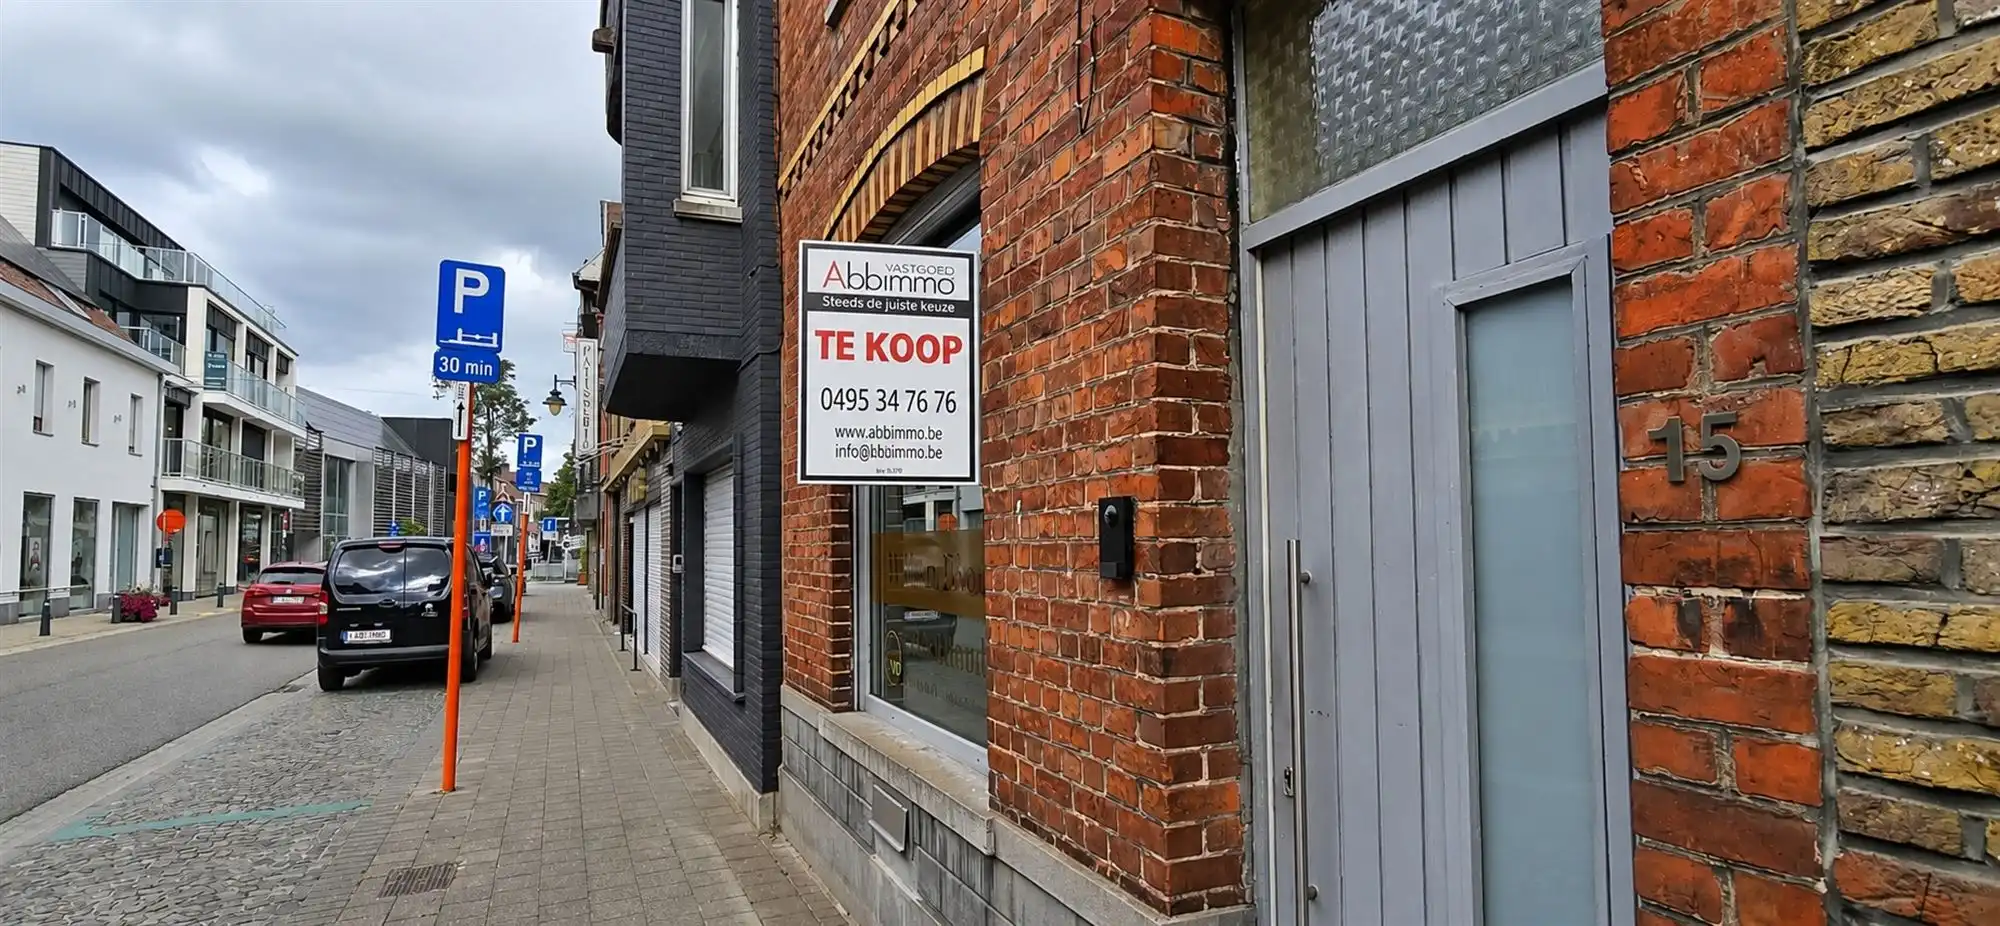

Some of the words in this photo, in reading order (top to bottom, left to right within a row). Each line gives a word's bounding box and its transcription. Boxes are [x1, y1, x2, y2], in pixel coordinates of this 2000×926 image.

[822, 260, 955, 295] Abbimmo
[885, 263, 955, 276] VASTGOED
[453, 268, 490, 315] P
[822, 295, 864, 309] Steeds
[866, 297, 882, 310] de
[885, 298, 918, 312] juiste
[920, 300, 955, 313] keuze
[815, 329, 855, 361] TE
[866, 332, 963, 364] KOOP
[438, 355, 459, 374] 30
[464, 358, 494, 378] min
[820, 387, 869, 411] 0495
[875, 388, 899, 412] 34
[905, 389, 928, 413] 76
[934, 390, 957, 413] 76
[835, 425, 943, 441] www.abbimmo.be
[523, 437, 537, 454] P
[1646, 411, 1740, 481] 15
[478, 491, 486, 501] P
